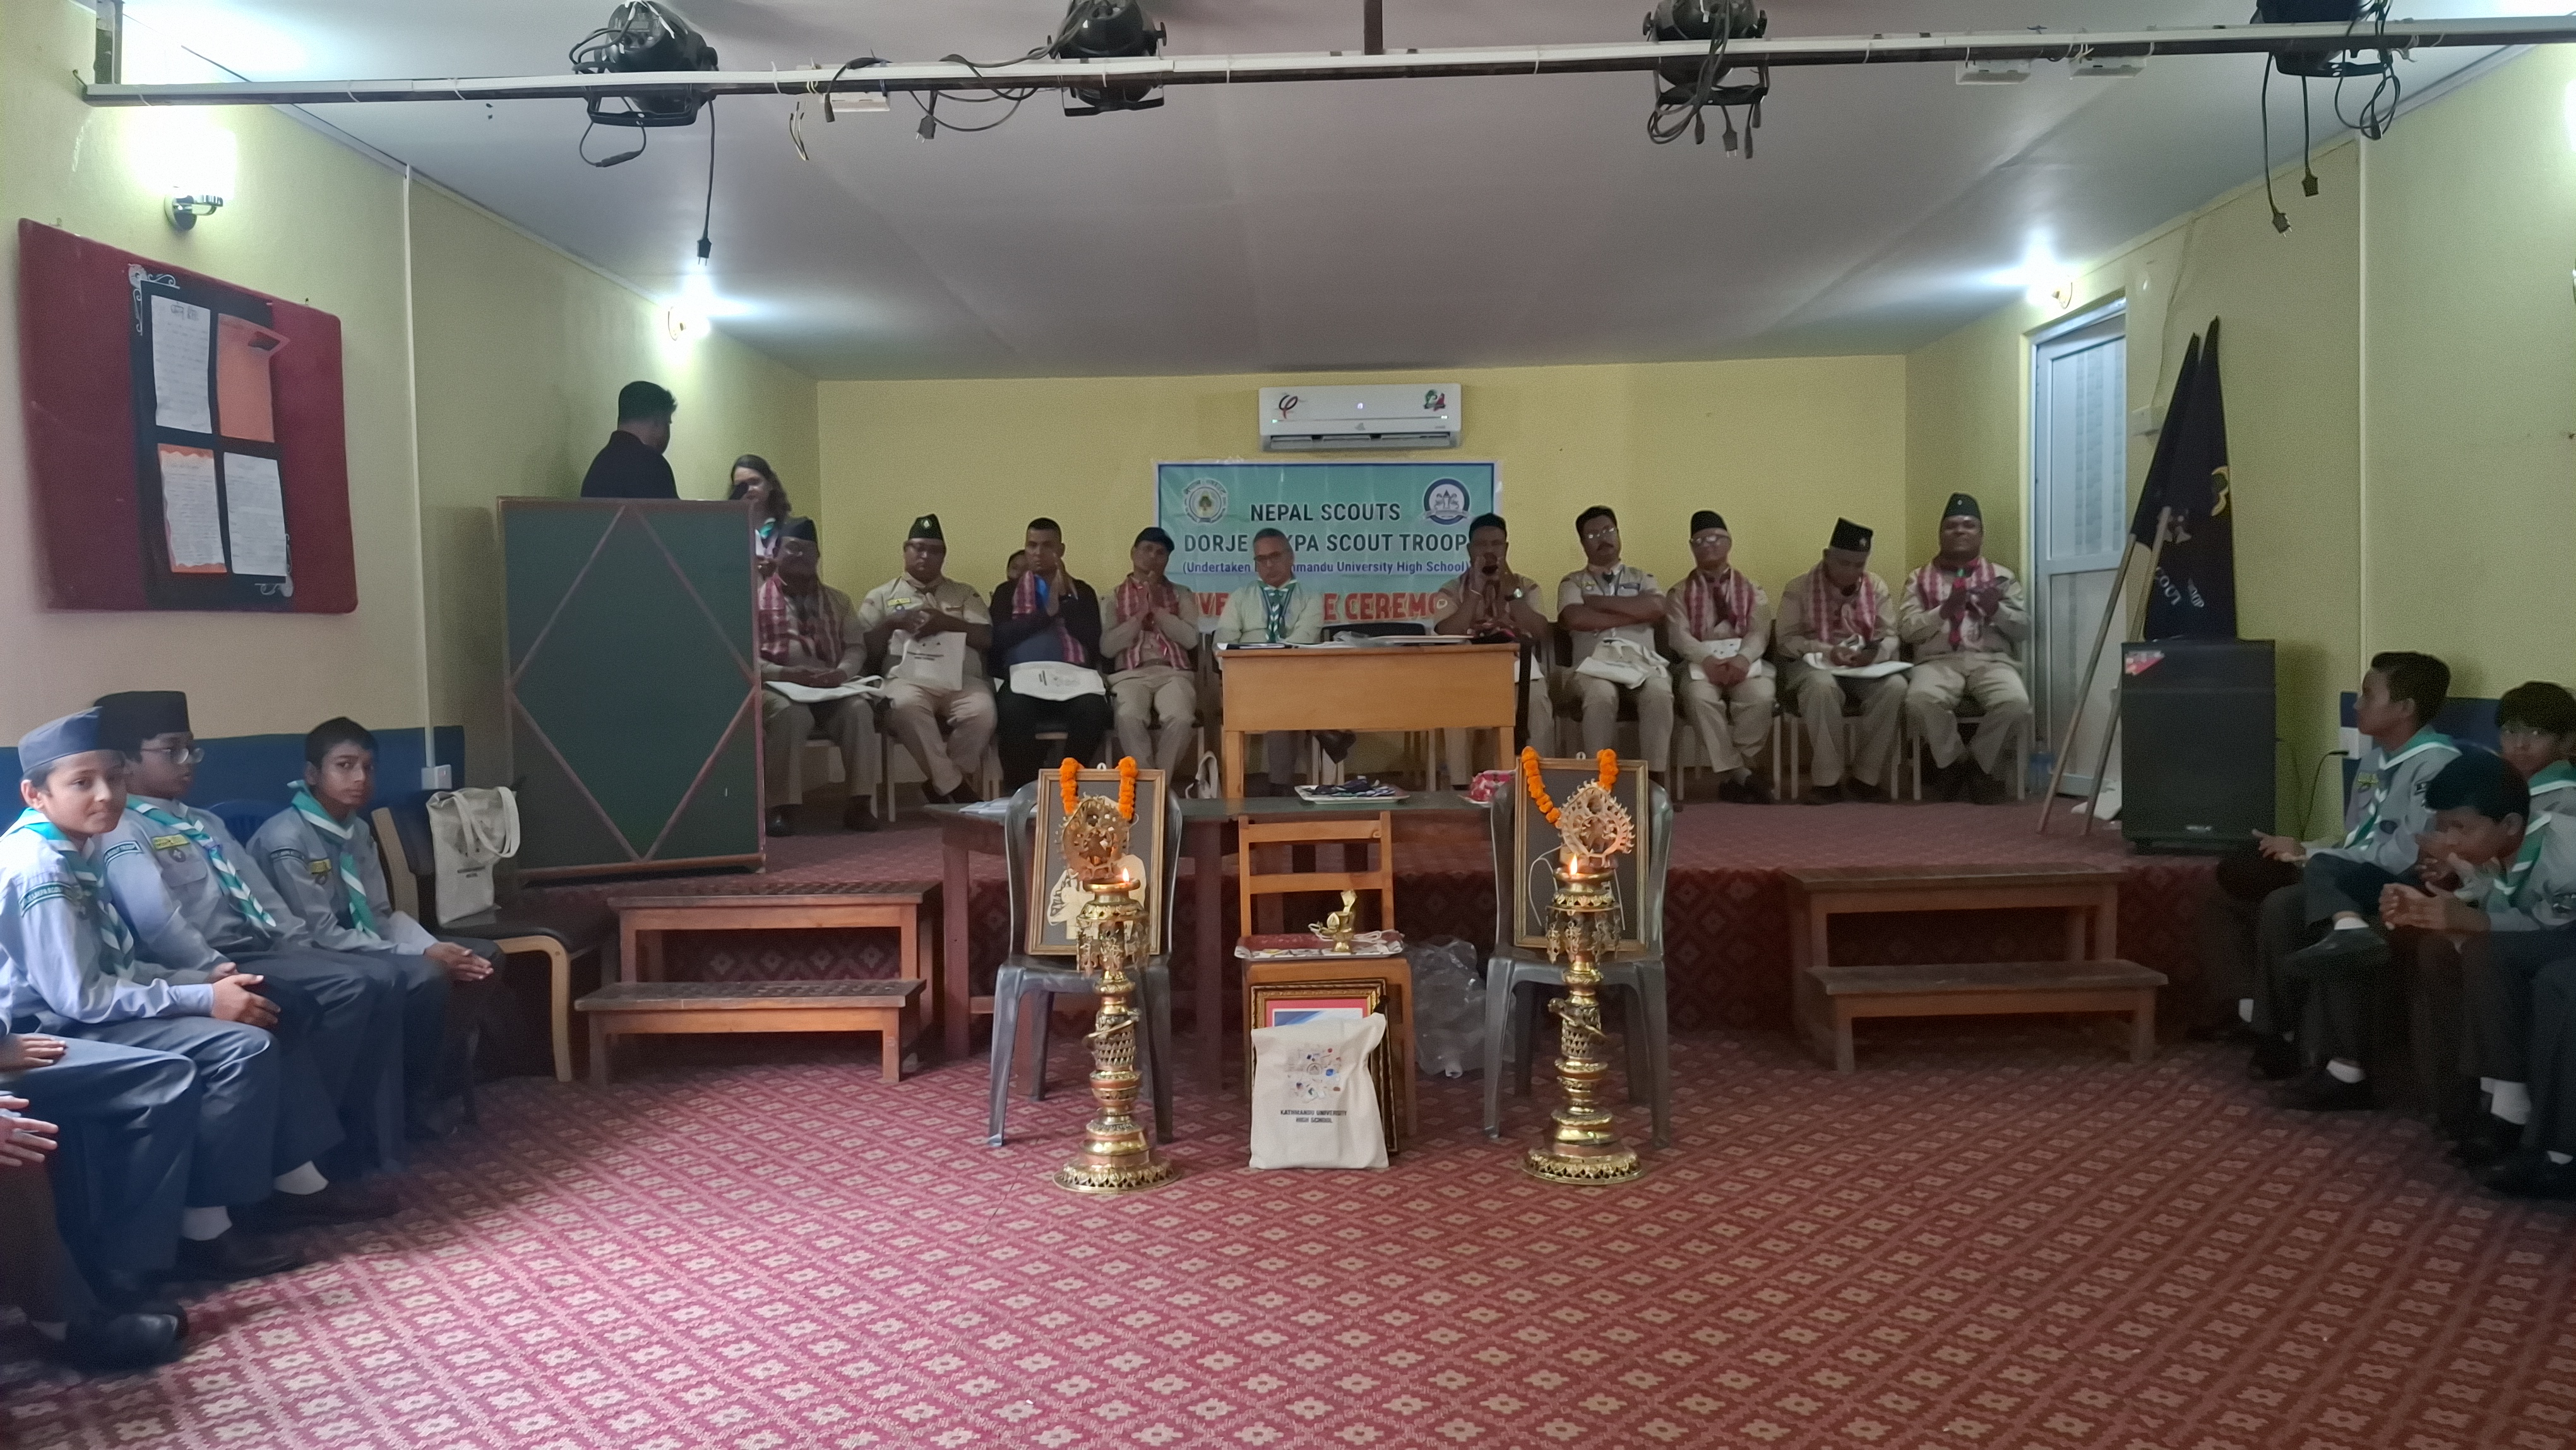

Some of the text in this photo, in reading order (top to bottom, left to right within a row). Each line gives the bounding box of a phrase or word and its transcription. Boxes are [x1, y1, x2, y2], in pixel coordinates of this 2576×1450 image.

[1250, 503, 1401, 522] NEPAL SCOUTS
[1184, 534, 1249, 552] DORJE
[1327, 534, 1393, 551] SCOUT
[1399, 534, 1467, 551] TROOP
[1183, 561, 1251, 575] (Undertaken
[1337, 561, 1393, 575] University
[1397, 561, 1422, 575] High
